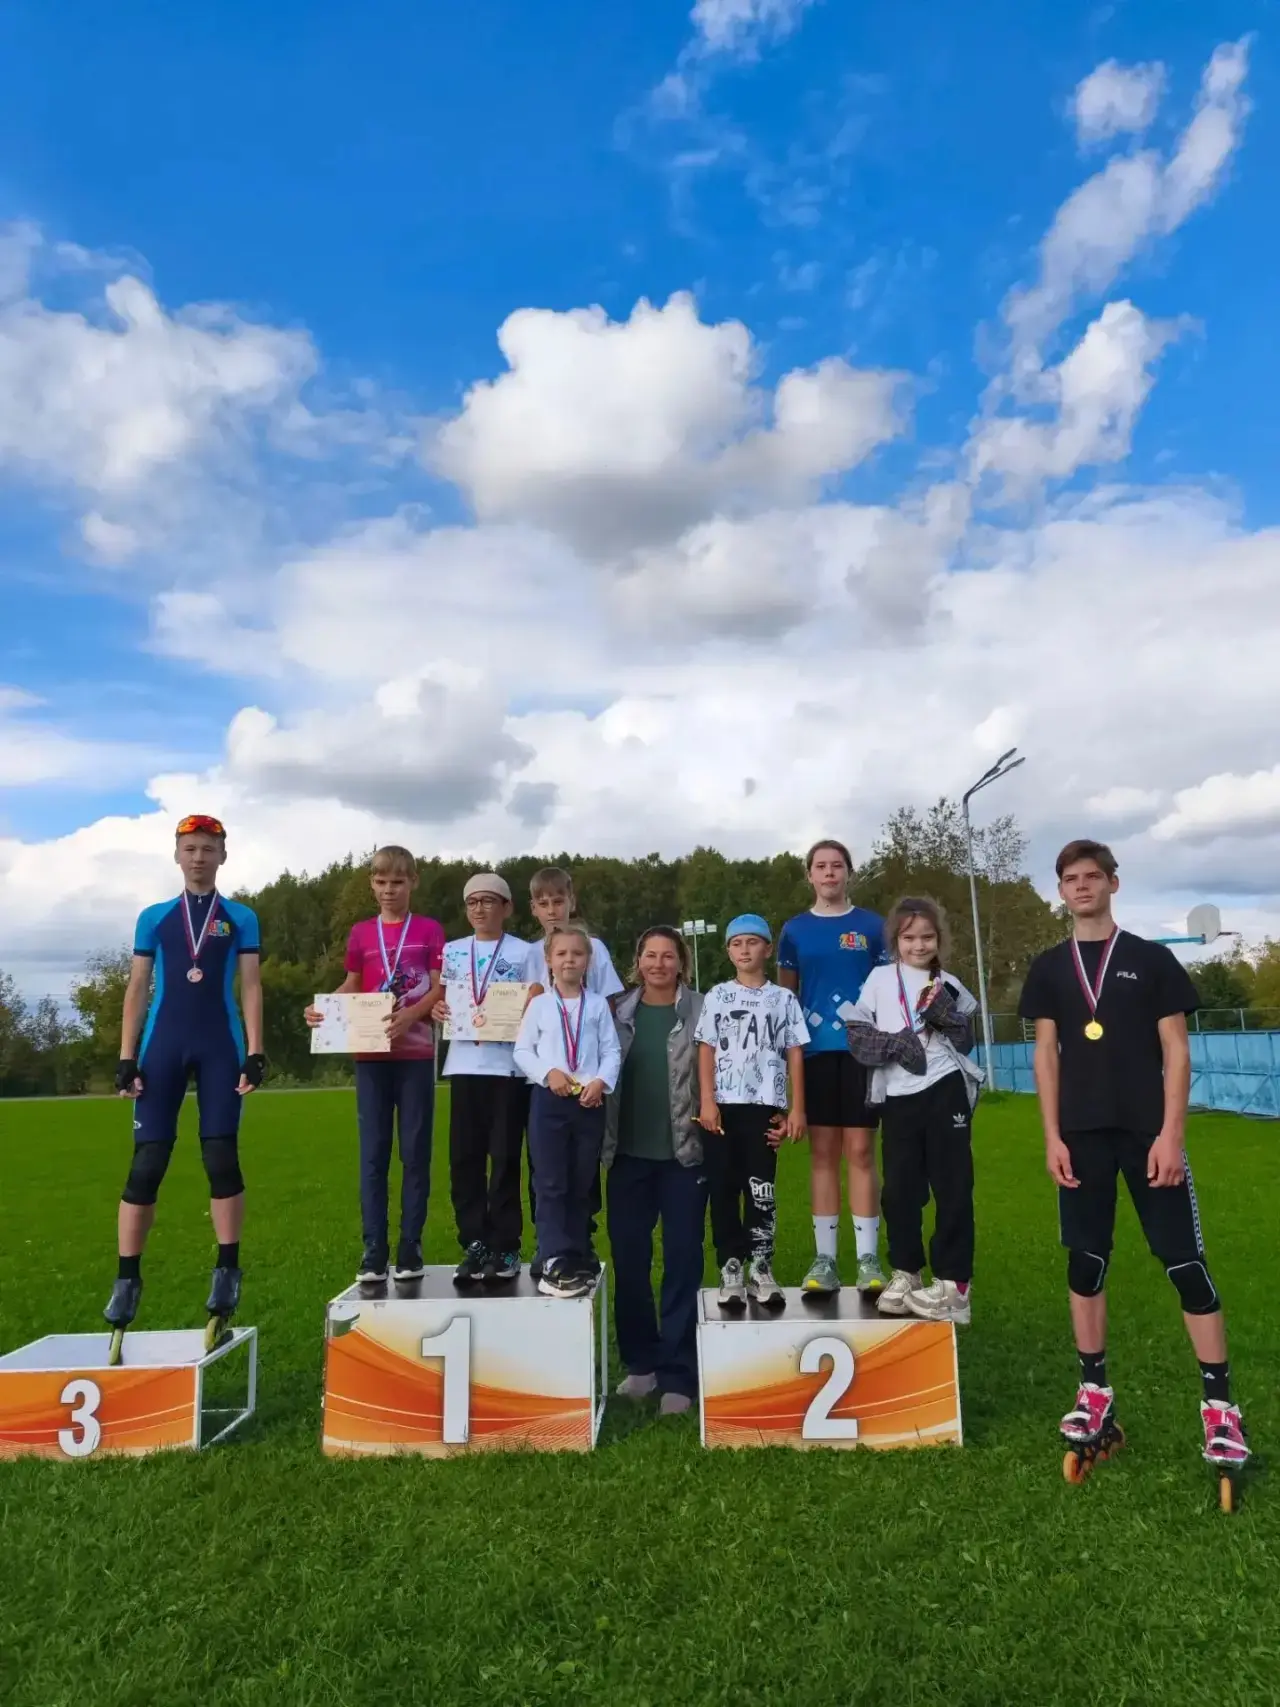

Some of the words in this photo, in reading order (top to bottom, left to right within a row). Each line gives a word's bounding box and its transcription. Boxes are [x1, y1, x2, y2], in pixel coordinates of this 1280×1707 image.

[1116, 970, 1137, 979] FILA
[59, 1379, 101, 1457] 3
[422, 1316, 471, 1444] 1
[799, 1336, 858, 1440] 2
